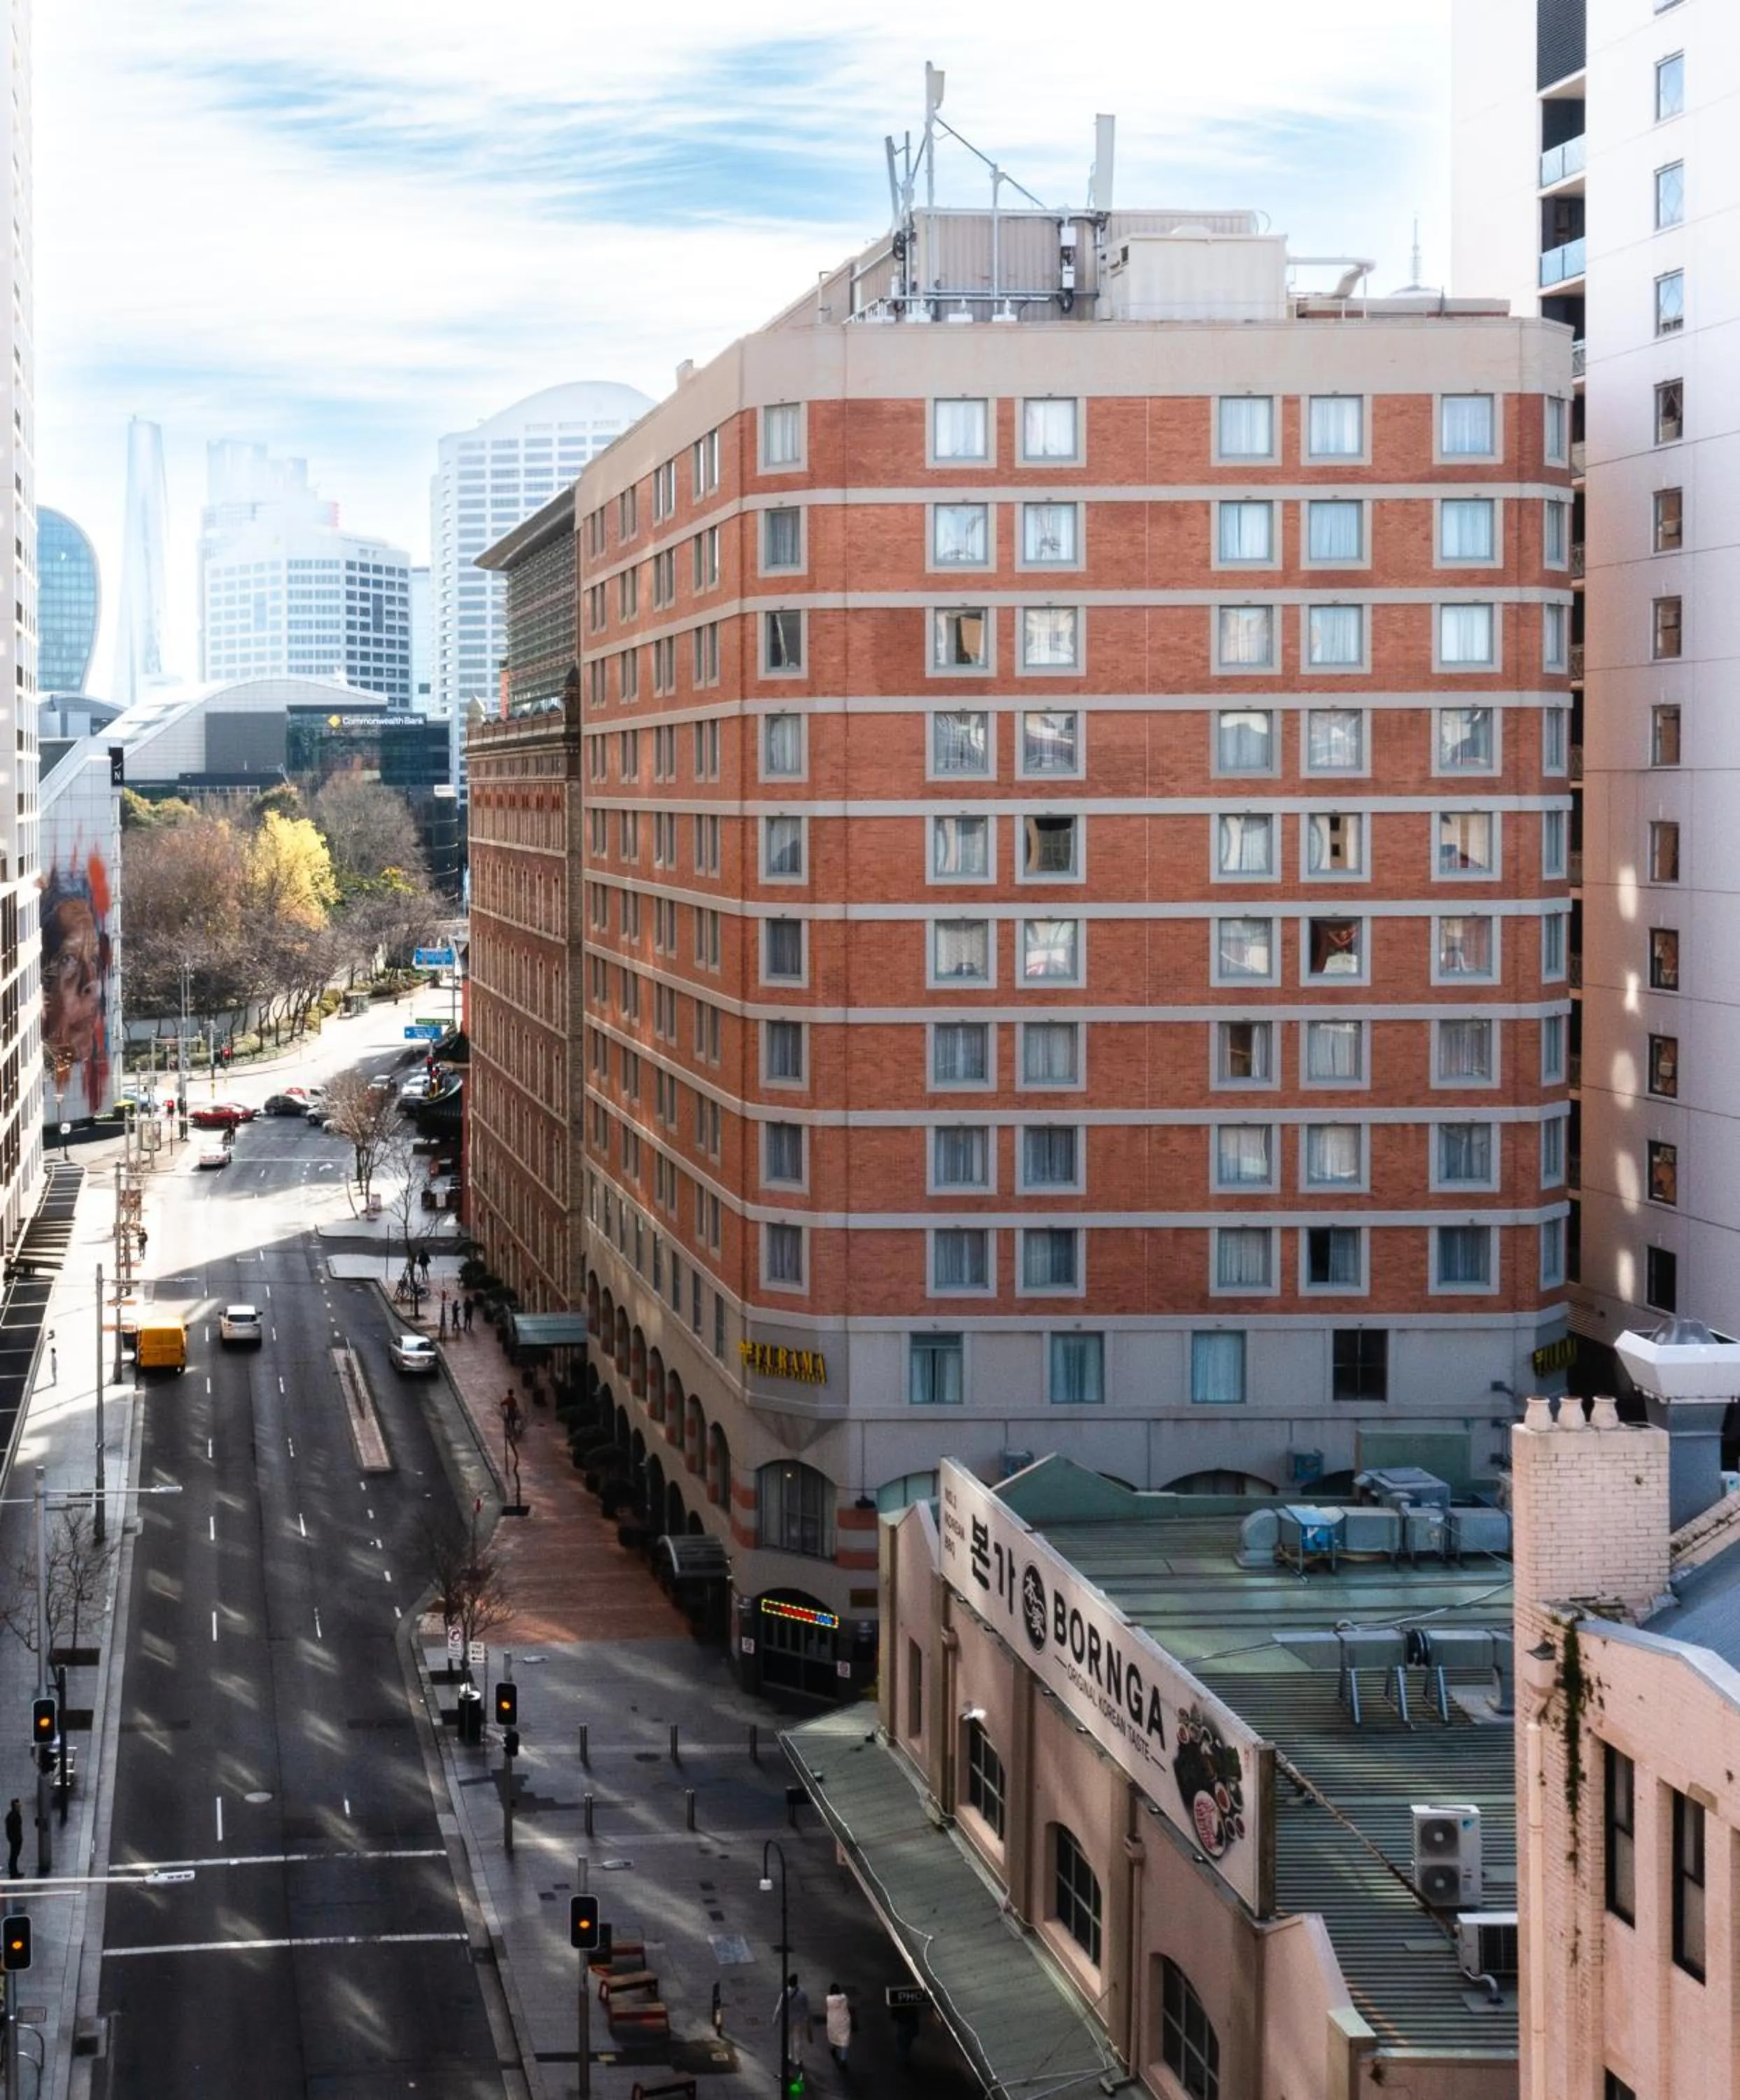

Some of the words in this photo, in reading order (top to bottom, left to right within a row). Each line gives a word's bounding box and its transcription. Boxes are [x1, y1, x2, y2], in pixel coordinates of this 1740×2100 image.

[342, 715, 403, 725] Commonwealth
[404, 715, 423, 724] Bank
[945, 1510, 964, 1541] KOREAN
[971, 1513, 1016, 1615] 본가
[1054, 1589, 1166, 1751] BORNGA
[1067, 1663, 1097, 1707] ORIGINAL
[1098, 1694, 1126, 1737] KOREAN
[1128, 1724, 1150, 1762] TASTE
